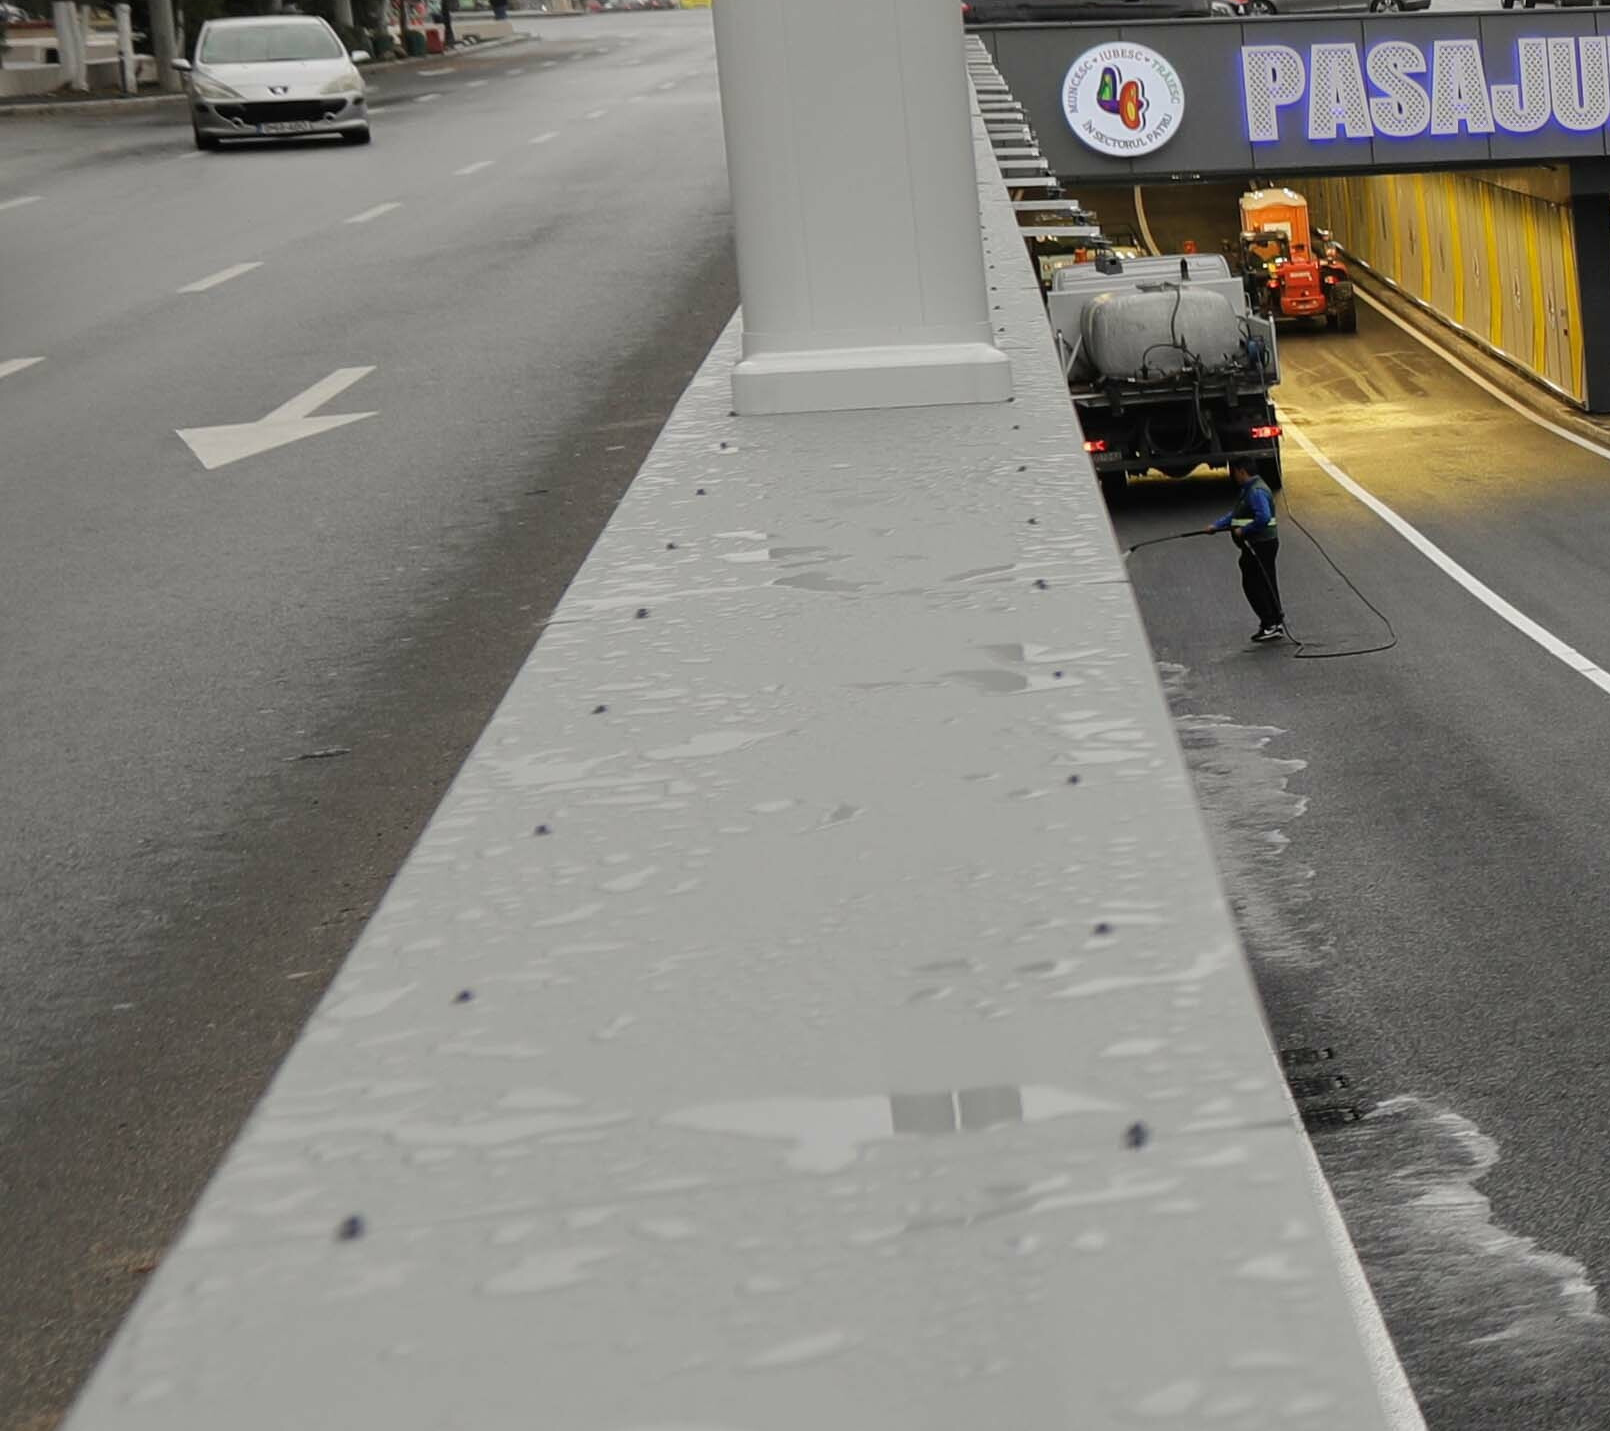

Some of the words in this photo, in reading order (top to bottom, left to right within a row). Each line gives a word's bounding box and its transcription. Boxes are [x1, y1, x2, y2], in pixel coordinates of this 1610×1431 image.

[1067, 60, 1095, 114] MUNCESC
[1099, 48, 1144, 62] IUBESC
[1094, 132, 1148, 150] SECTORUL
[1146, 112, 1173, 143] PATRU
